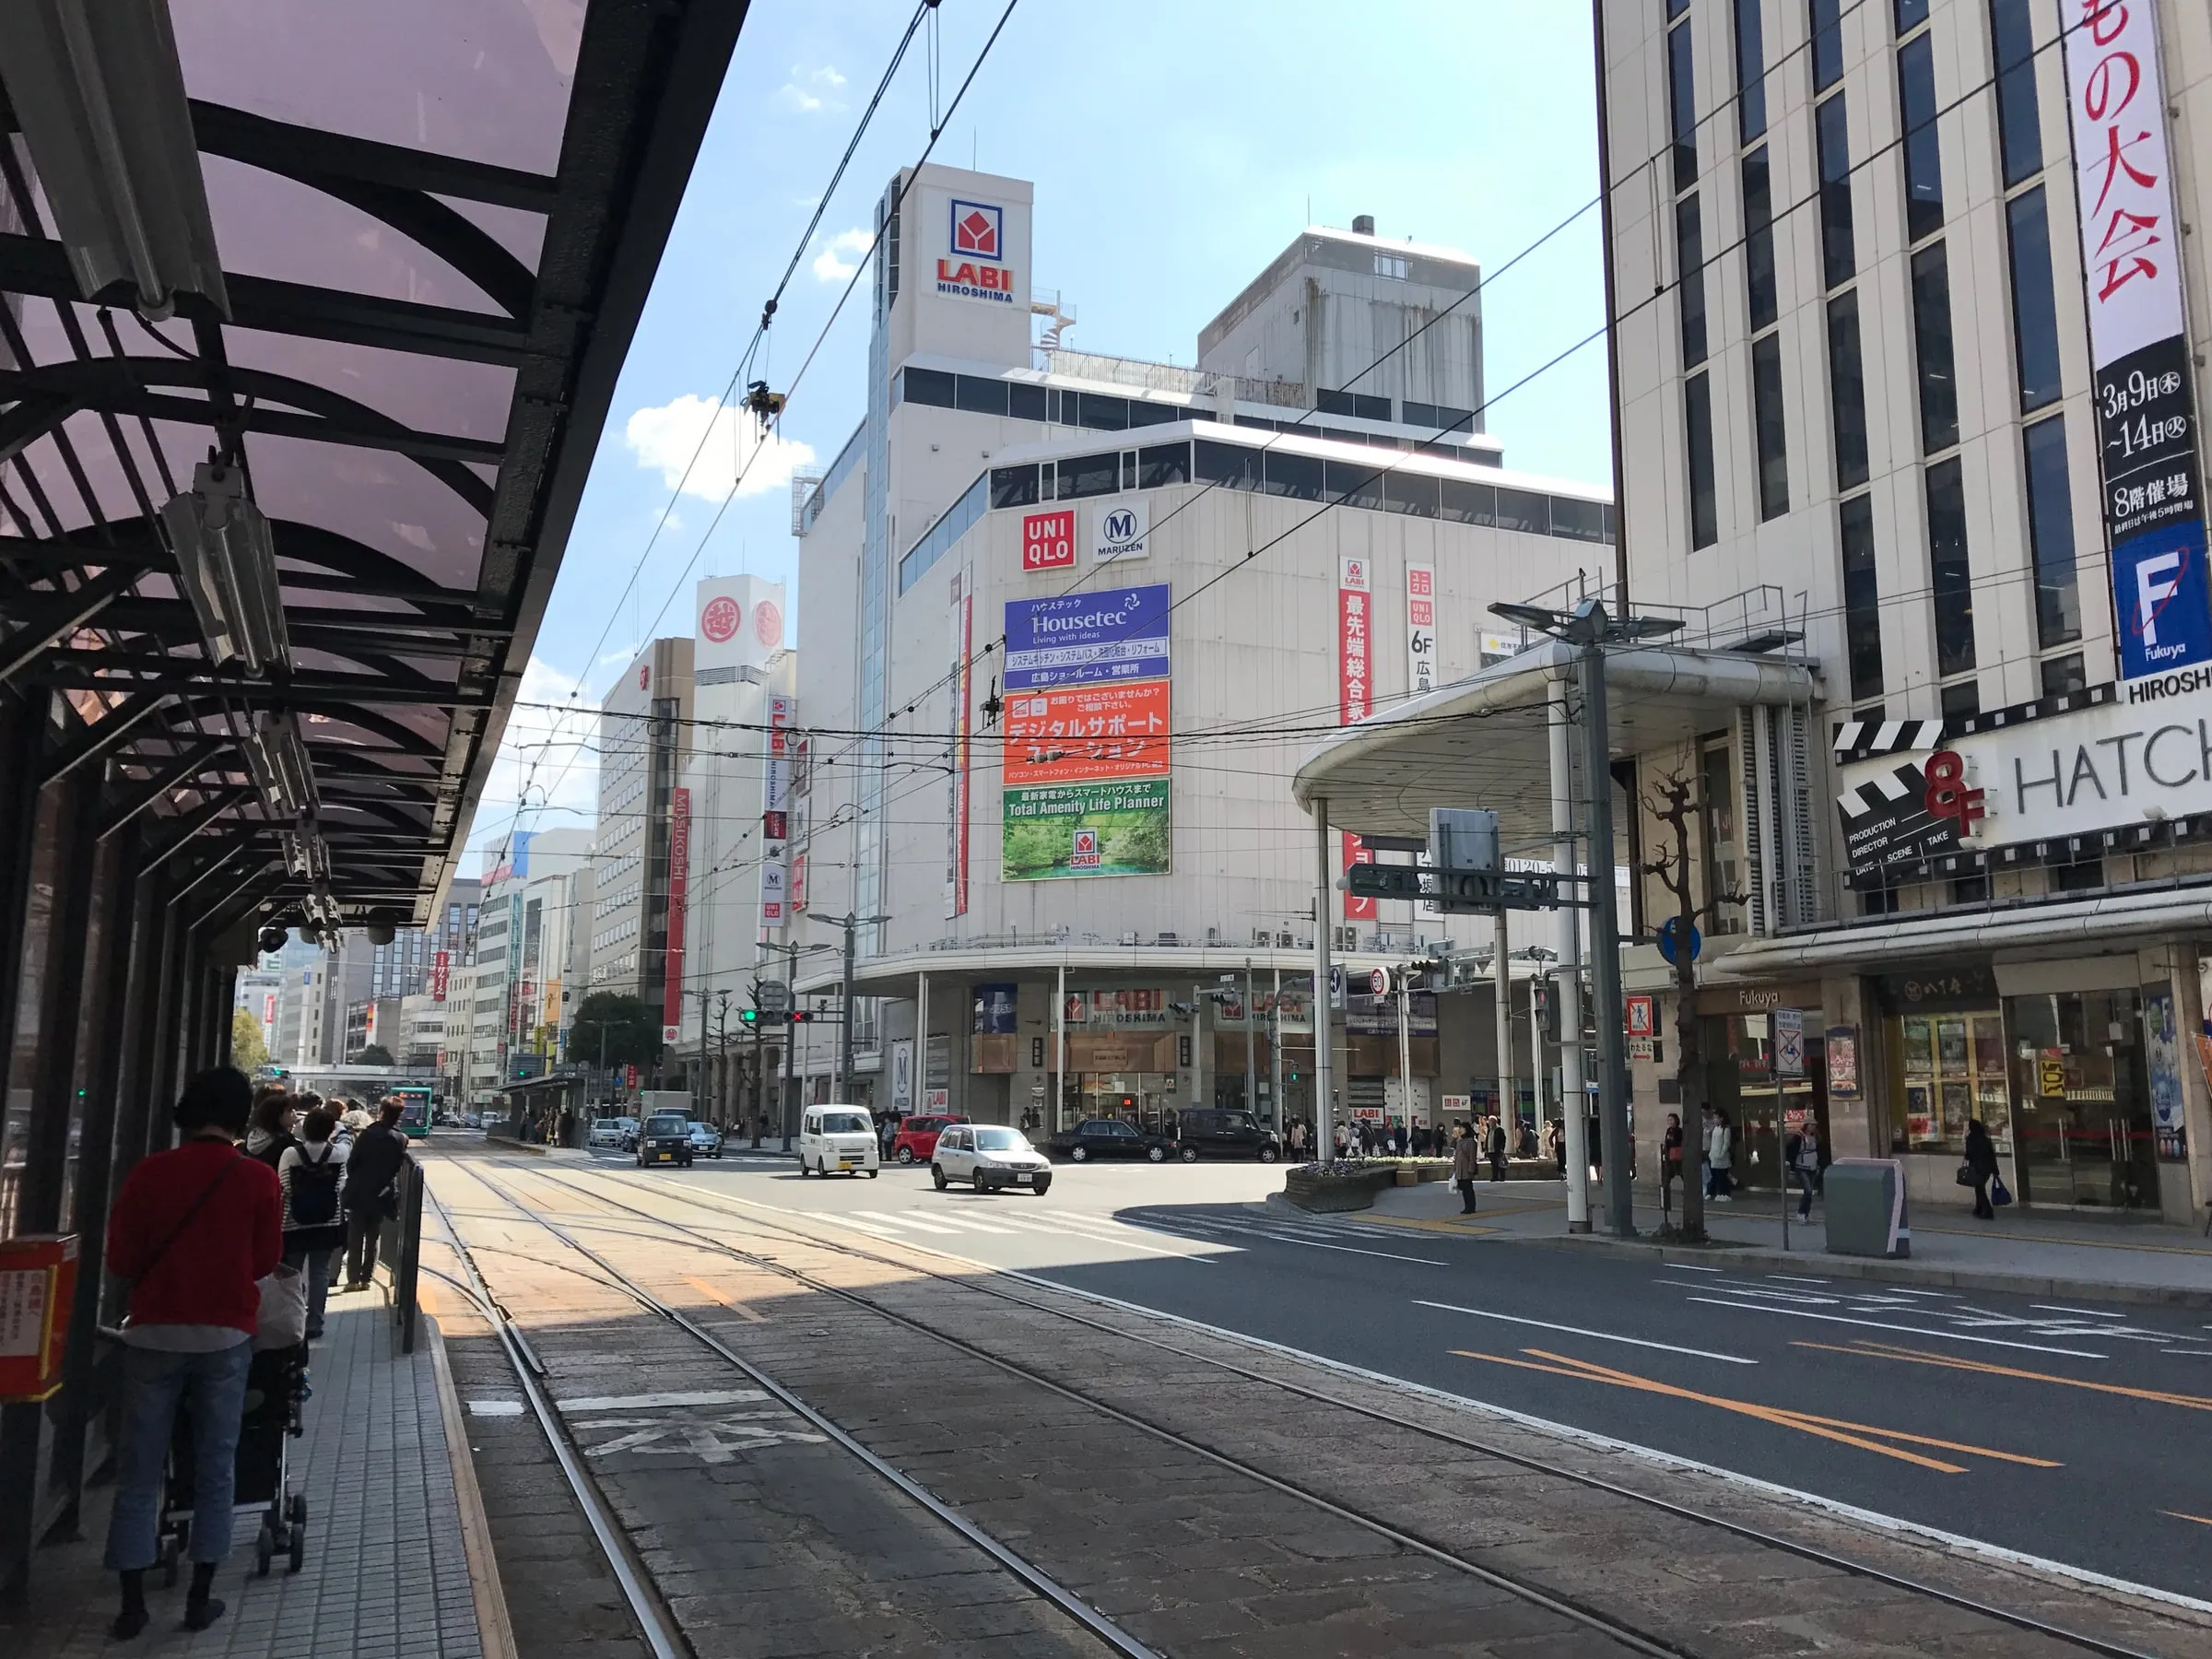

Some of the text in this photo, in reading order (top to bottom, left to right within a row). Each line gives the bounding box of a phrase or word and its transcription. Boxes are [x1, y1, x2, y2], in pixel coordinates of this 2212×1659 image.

[936, 257, 1014, 291] LABI
[936, 281, 1014, 304] HIROSHIMA
[2113, 472, 2189, 518] 8階催場
[1028, 516, 1065, 540] UNI
[1107, 515, 1134, 538] M
[1028, 539, 1069, 567] QLO
[1098, 542, 1144, 557] MARUZEN
[1345, 577, 1365, 585] LABI
[1411, 572, 1430, 583] ユニ
[1411, 582, 1430, 594] クロ
[1030, 598, 1082, 613] ハウステック
[1412, 602, 1430, 613] UNI
[1031, 610, 1127, 634] Housetec
[1412, 613, 1430, 624] QLO
[1032, 630, 1100, 645] Living with ideas
[1411, 629, 1433, 654] 6F
[1346, 594, 1366, 724] 最先端総合家
[2145, 643, 2186, 662] Fukuya
[1008, 711, 1164, 745] デジタルサポート
[2014, 718, 2212, 816] HATC
[770, 760, 778, 808] HIROSHIMA
[1020, 783, 1152, 802] 最新家電からスマートハウスまで
[1924, 749, 1986, 838] 8F
[1008, 794, 1165, 818] Total Amenity Life Planner
[1848, 817, 1898, 845] PRODUCTION
[1851, 836, 1889, 859] DIRECTOR
[1854, 830, 1949, 877] DATE SCENE TAKE
[1070, 854, 1100, 865] LABI
[1093, 988, 1164, 1012] LABI
[1739, 991, 1780, 1008] Fukuya
[1093, 1013, 1166, 1024] HIROSHIMA
[1630, 1043, 1653, 1053] わたるな
[1353, 1109, 1380, 1118] LABI
